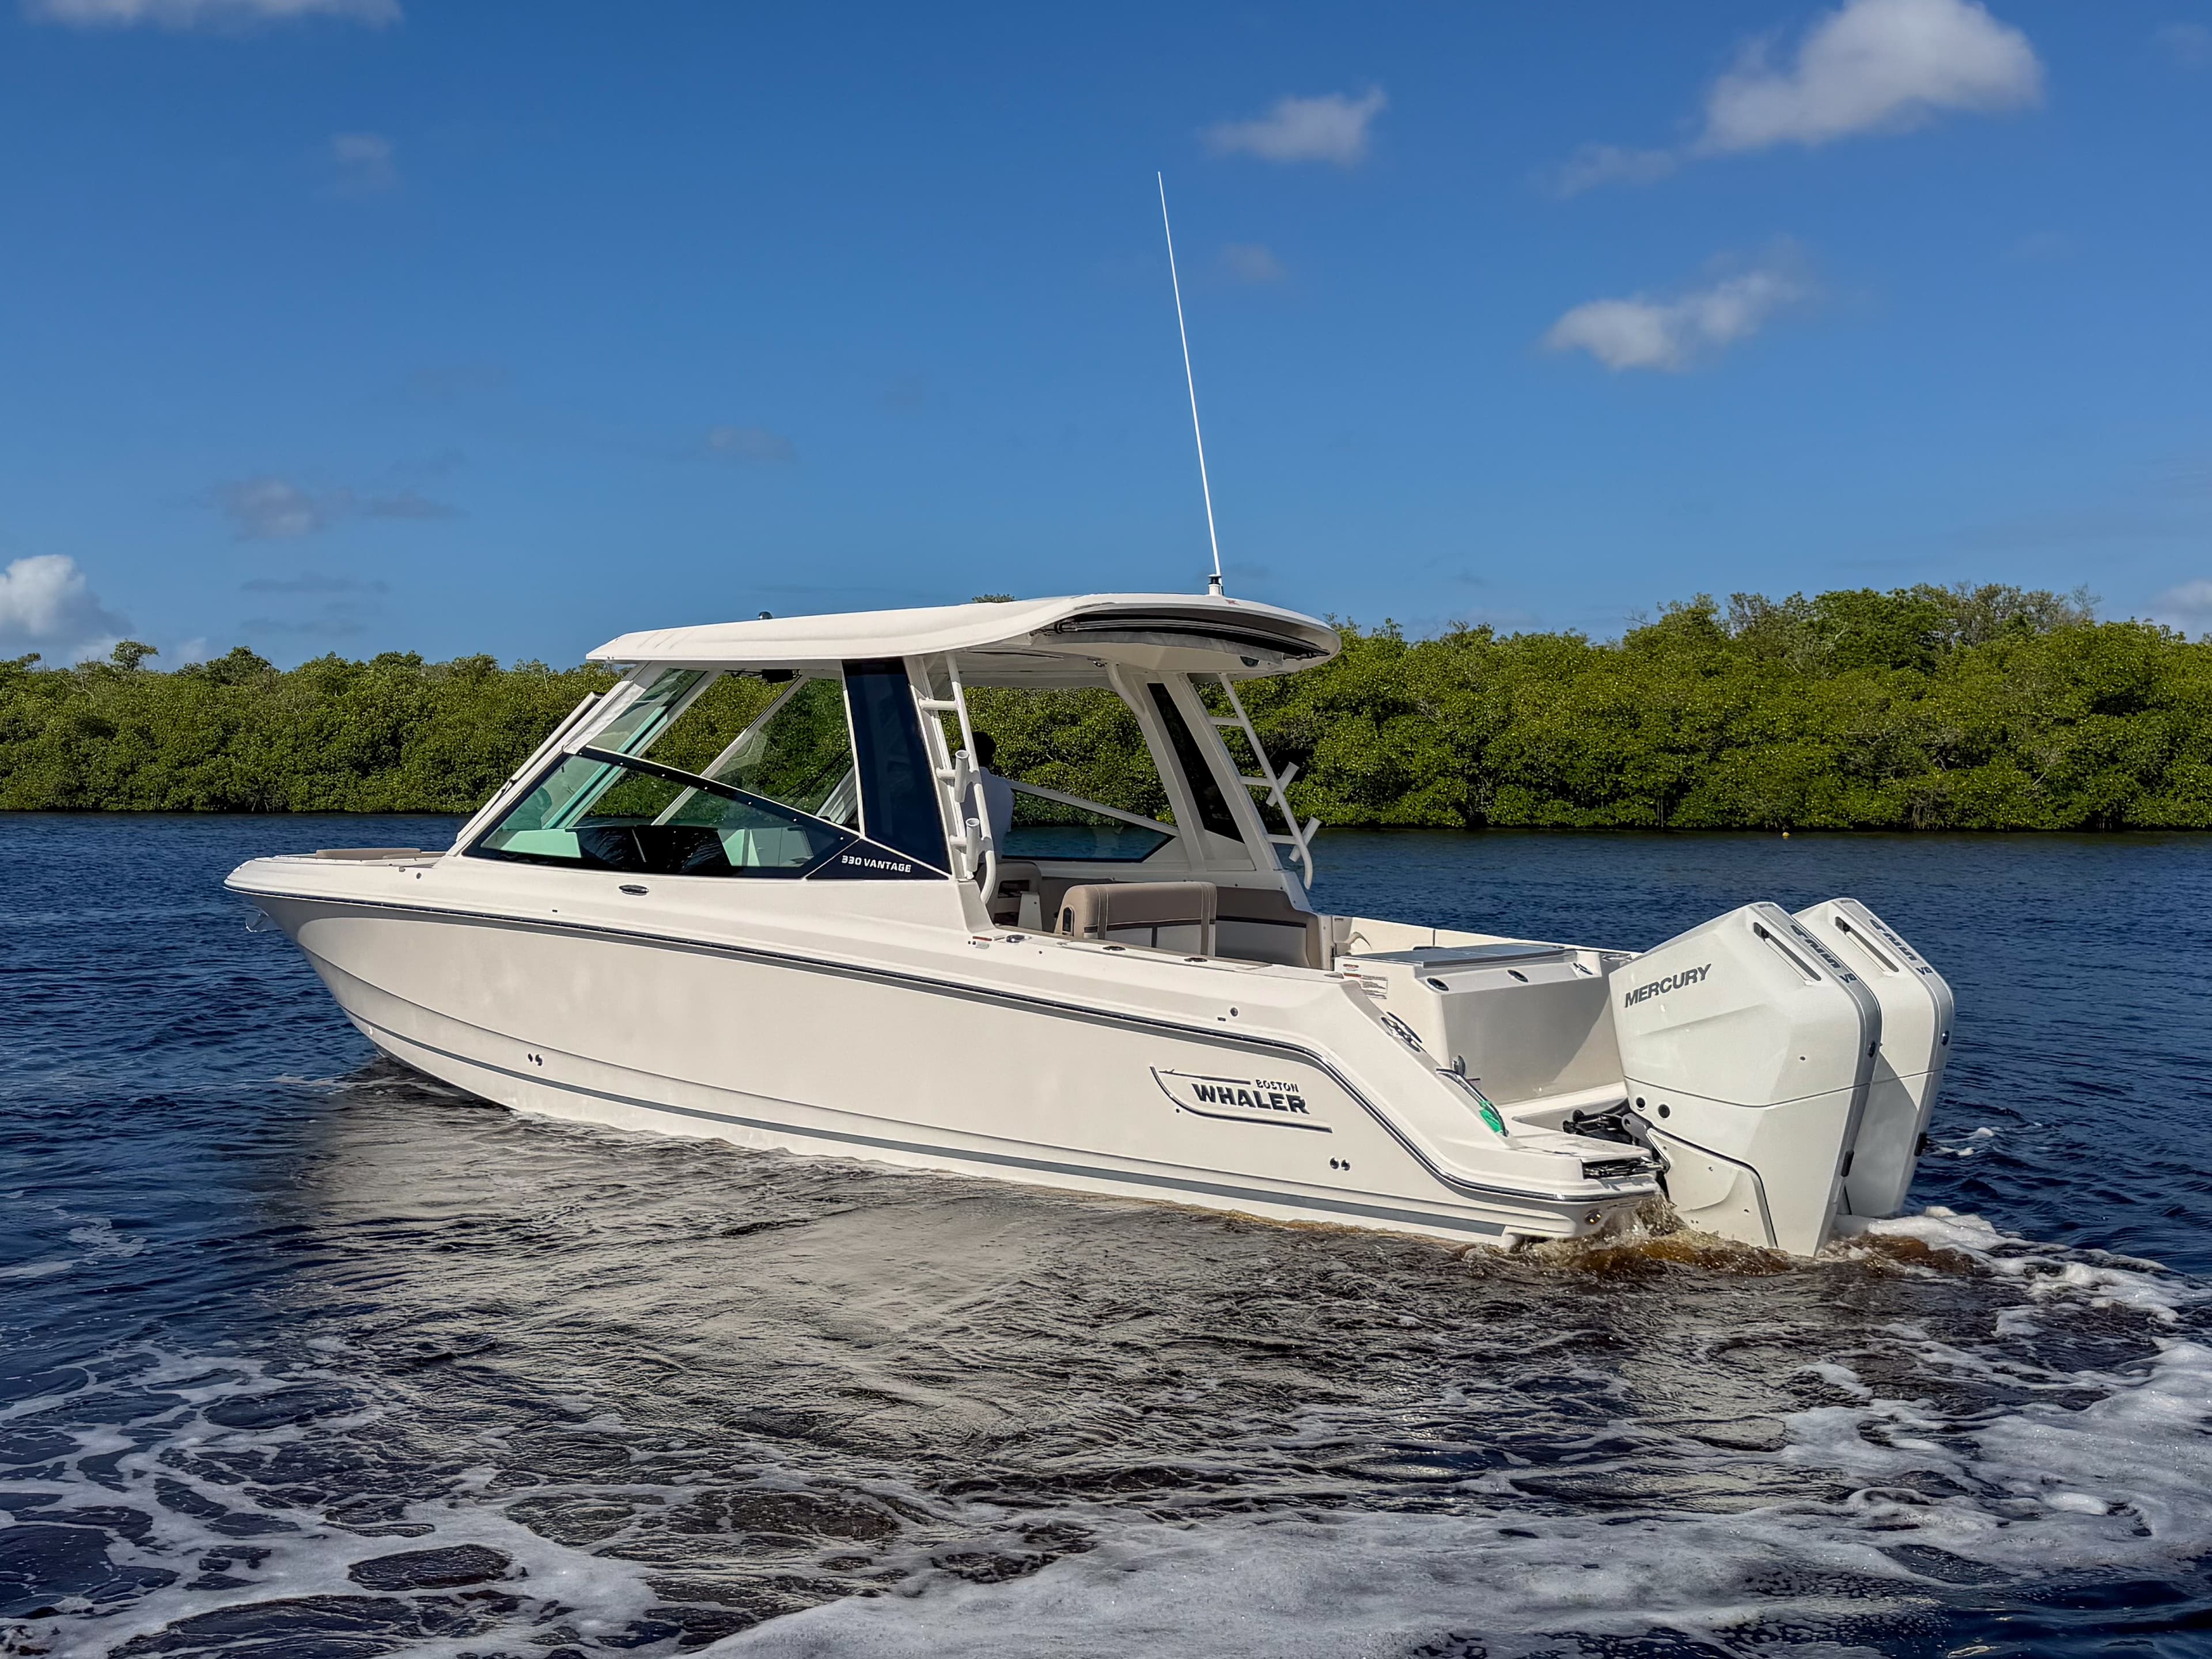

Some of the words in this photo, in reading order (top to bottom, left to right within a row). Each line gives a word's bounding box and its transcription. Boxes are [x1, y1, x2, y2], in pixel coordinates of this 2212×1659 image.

[842, 855, 862, 866] 330
[863, 858, 912, 873] VANTAGE
[1790, 925, 1840, 968] 425
[1624, 963, 1711, 1008] MERCURY
[1191, 1083, 1310, 1115] WHALER
[1256, 1078, 1299, 1093] BOSTON
